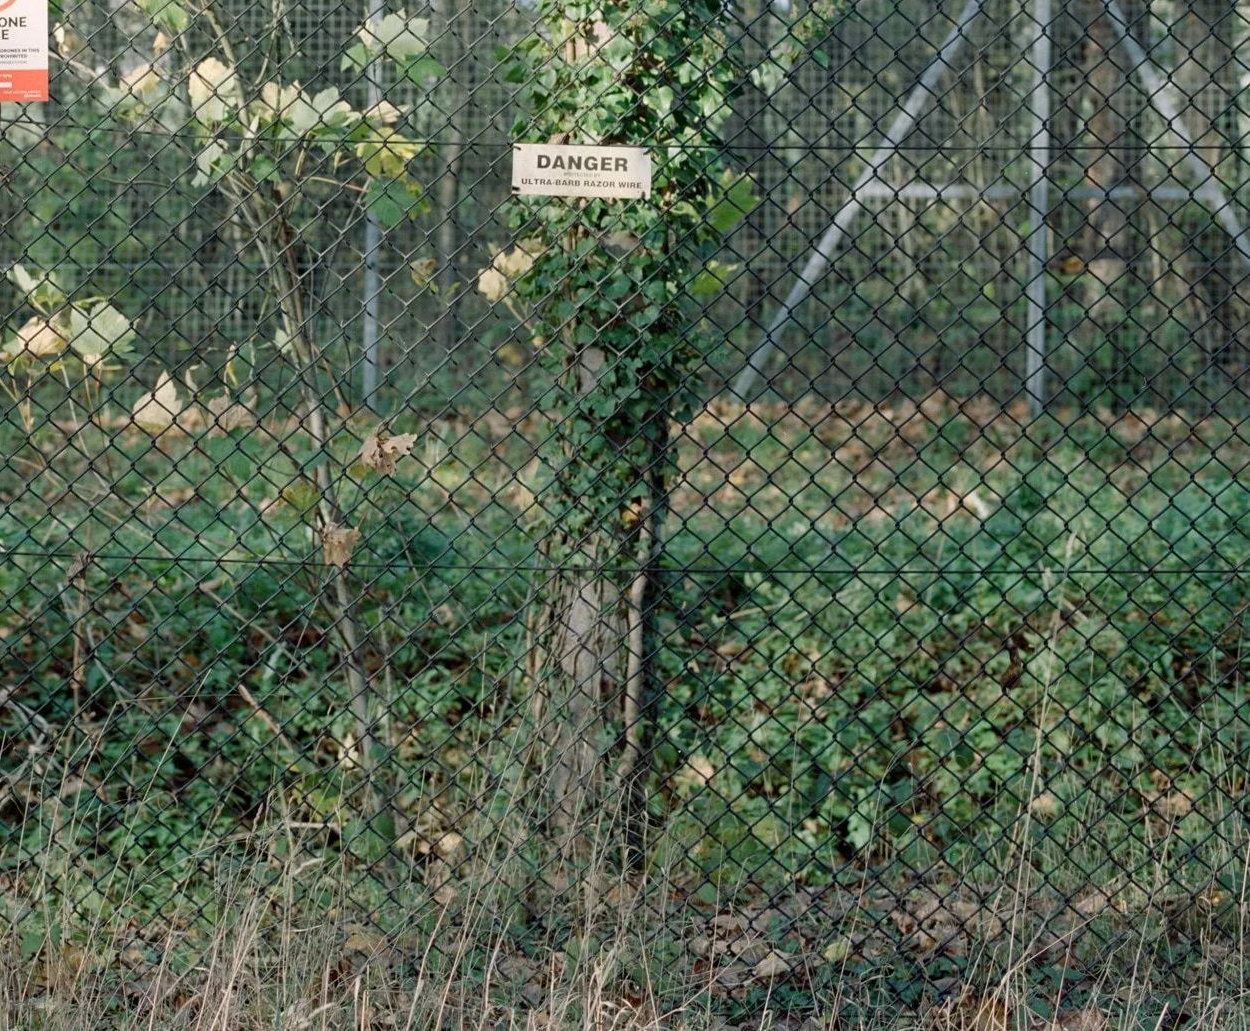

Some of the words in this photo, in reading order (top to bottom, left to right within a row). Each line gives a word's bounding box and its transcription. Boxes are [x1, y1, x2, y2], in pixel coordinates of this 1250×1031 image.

[536, 153, 629, 172] DANGER
[521, 177, 581, 187] ULTRA-BARB
[583, 179, 616, 188] RAZOR
[618, 181, 643, 189] WIRE
